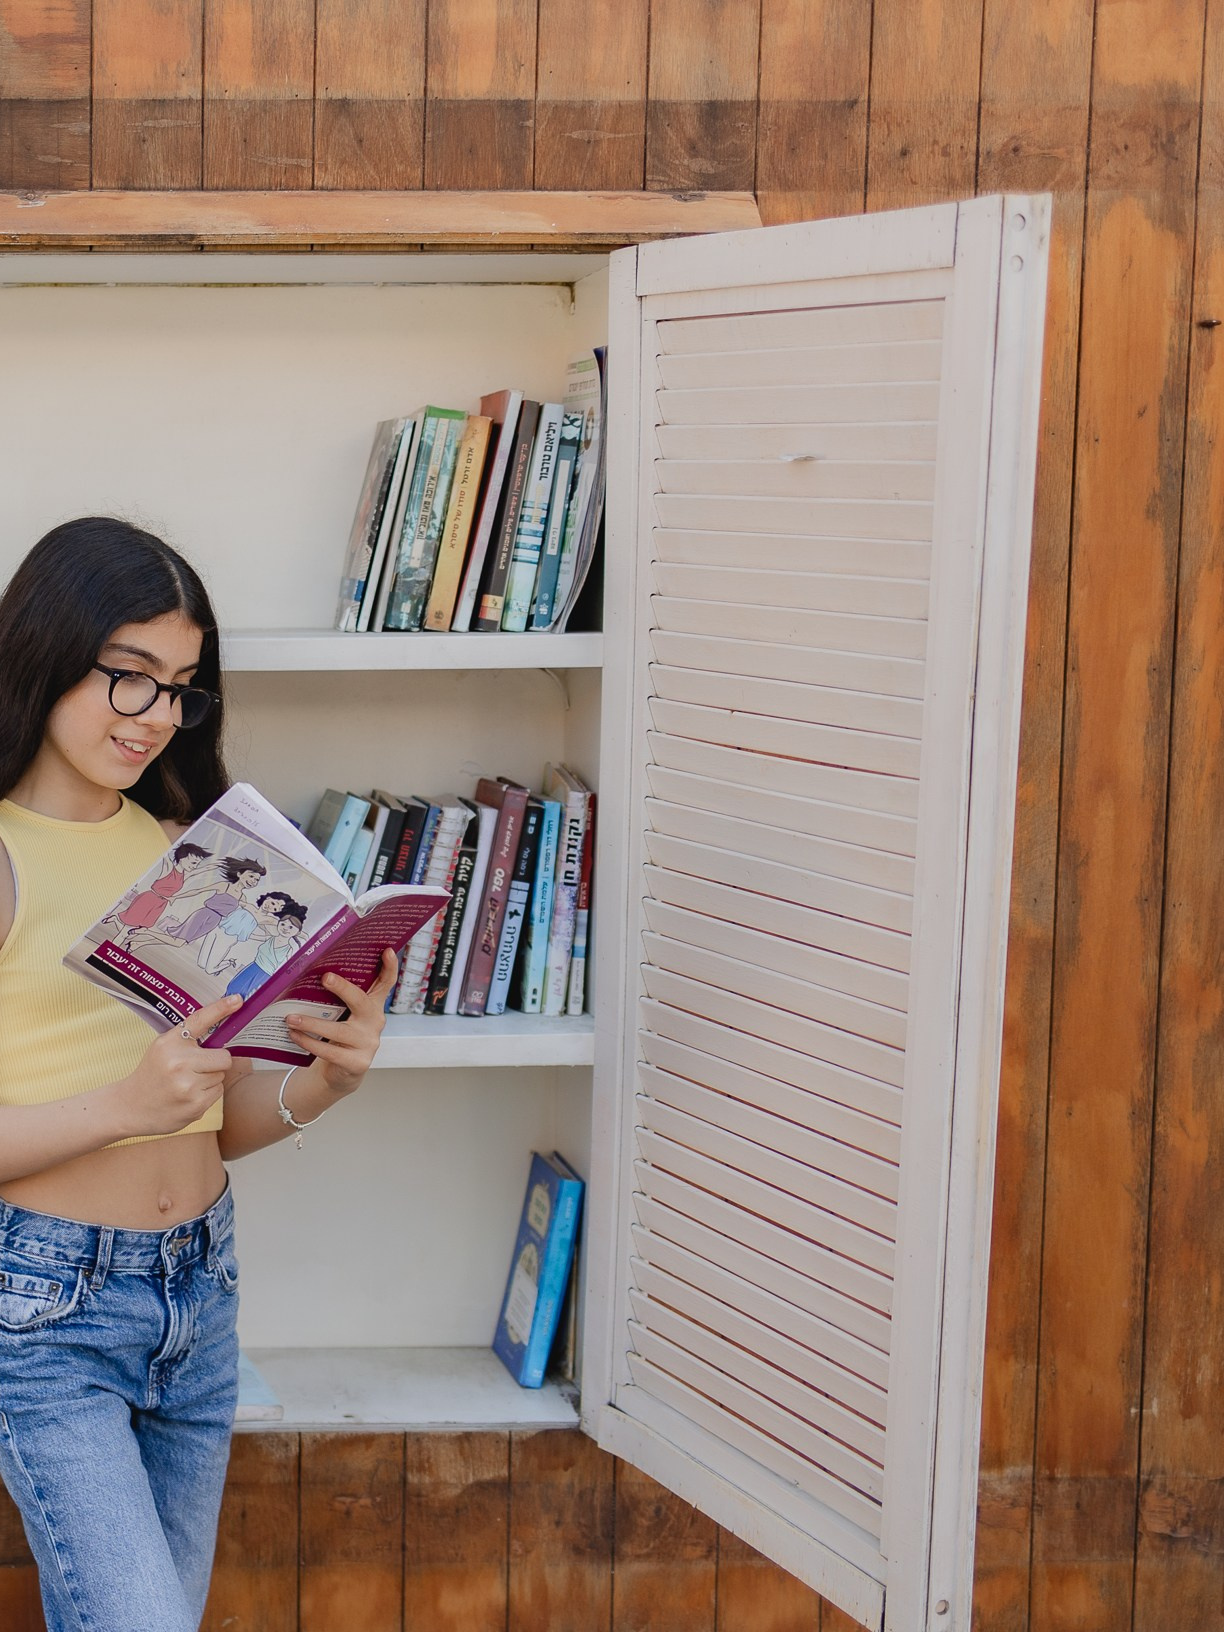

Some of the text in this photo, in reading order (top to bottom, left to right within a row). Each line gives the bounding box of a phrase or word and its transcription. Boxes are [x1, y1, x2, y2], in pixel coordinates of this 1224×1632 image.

[542, 421, 557, 452] ויליאם
[465, 447, 474, 463] אדם
[538, 453, 551, 481] טרבור
[460, 465, 470, 484] זרטל
[453, 509, 462, 522] של
[449, 523, 459, 548] סיסרא
[563, 818, 582, 886] נקודת חן
[491, 867, 505, 893] ספר
[439, 856, 474, 977] קניה ערכת הישרדות למטייל
[103, 947, 128, 967] יעבור
[496, 925, 516, 981] ההצהרה
[127, 962, 140, 974] זה
[155, 1001, 170, 1014] רום
